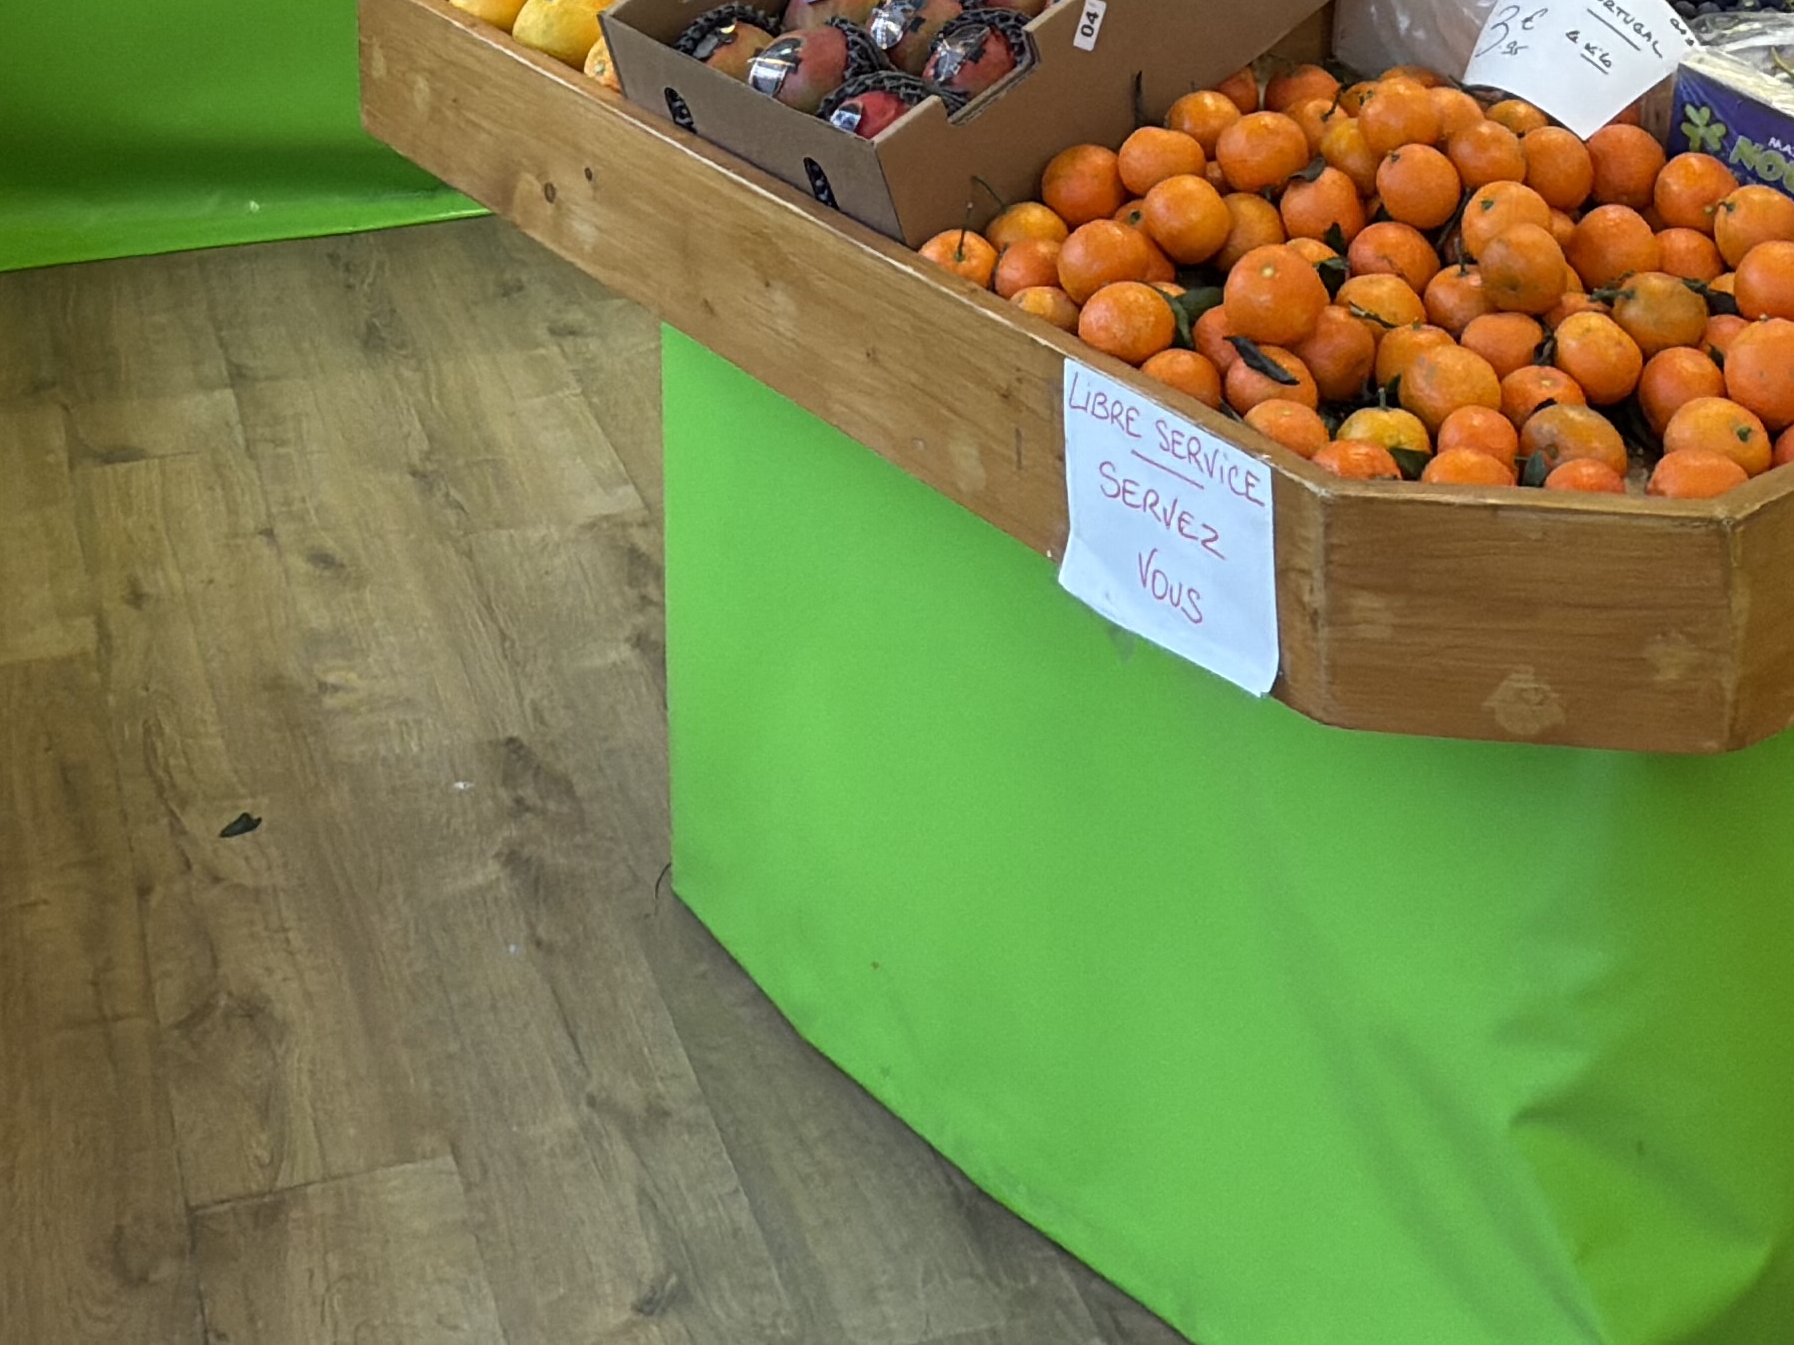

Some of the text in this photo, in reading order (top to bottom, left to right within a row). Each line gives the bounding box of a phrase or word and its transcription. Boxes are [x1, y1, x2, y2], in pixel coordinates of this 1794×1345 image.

[1081, 11, 1099, 37] 04
[1475, 5, 1520, 57] 3
[1521, 8, 1548, 31] €
[1069, 371, 1267, 508] LIBRE SERVICE
[1100, 461, 1227, 561] SERVEZ
[1138, 548, 1204, 625] VOUS
